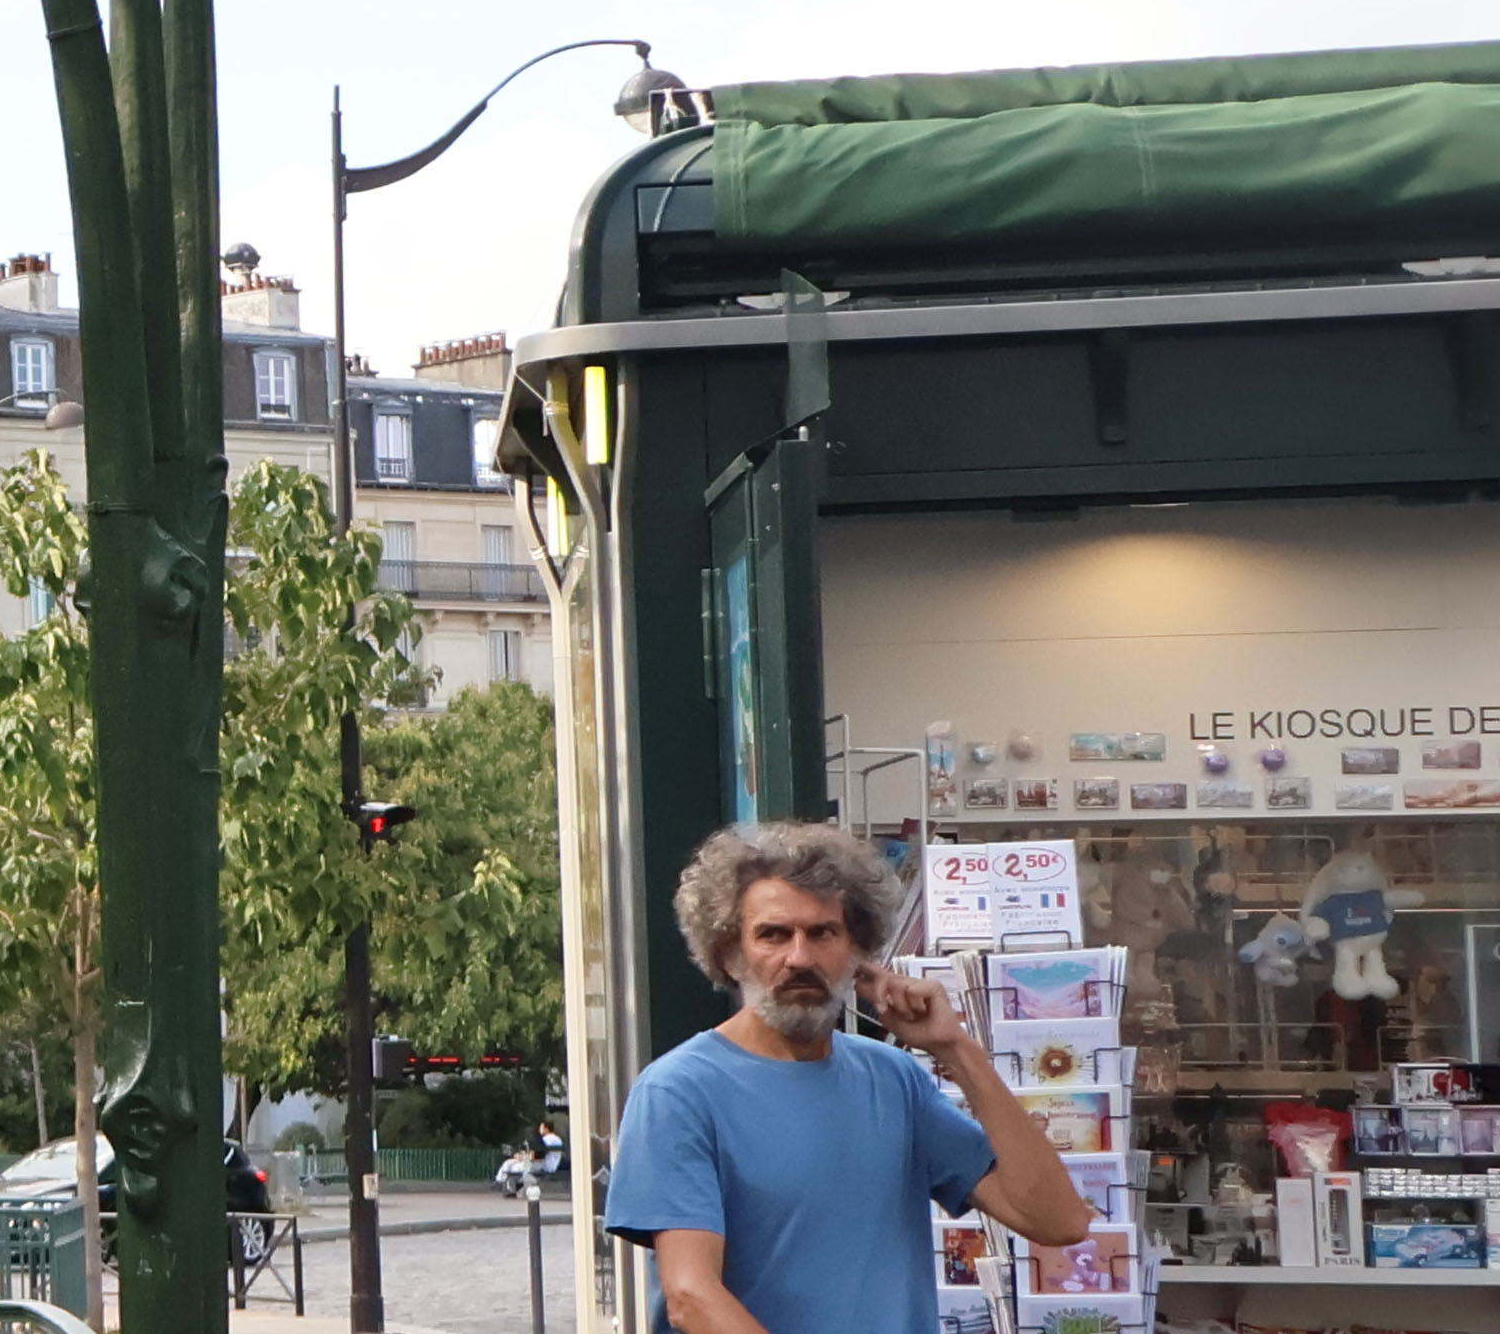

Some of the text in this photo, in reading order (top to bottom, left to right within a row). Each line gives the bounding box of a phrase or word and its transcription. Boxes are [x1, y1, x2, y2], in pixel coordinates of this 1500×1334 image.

[1189, 706, 1500, 740] LE KIOSQUE DE
